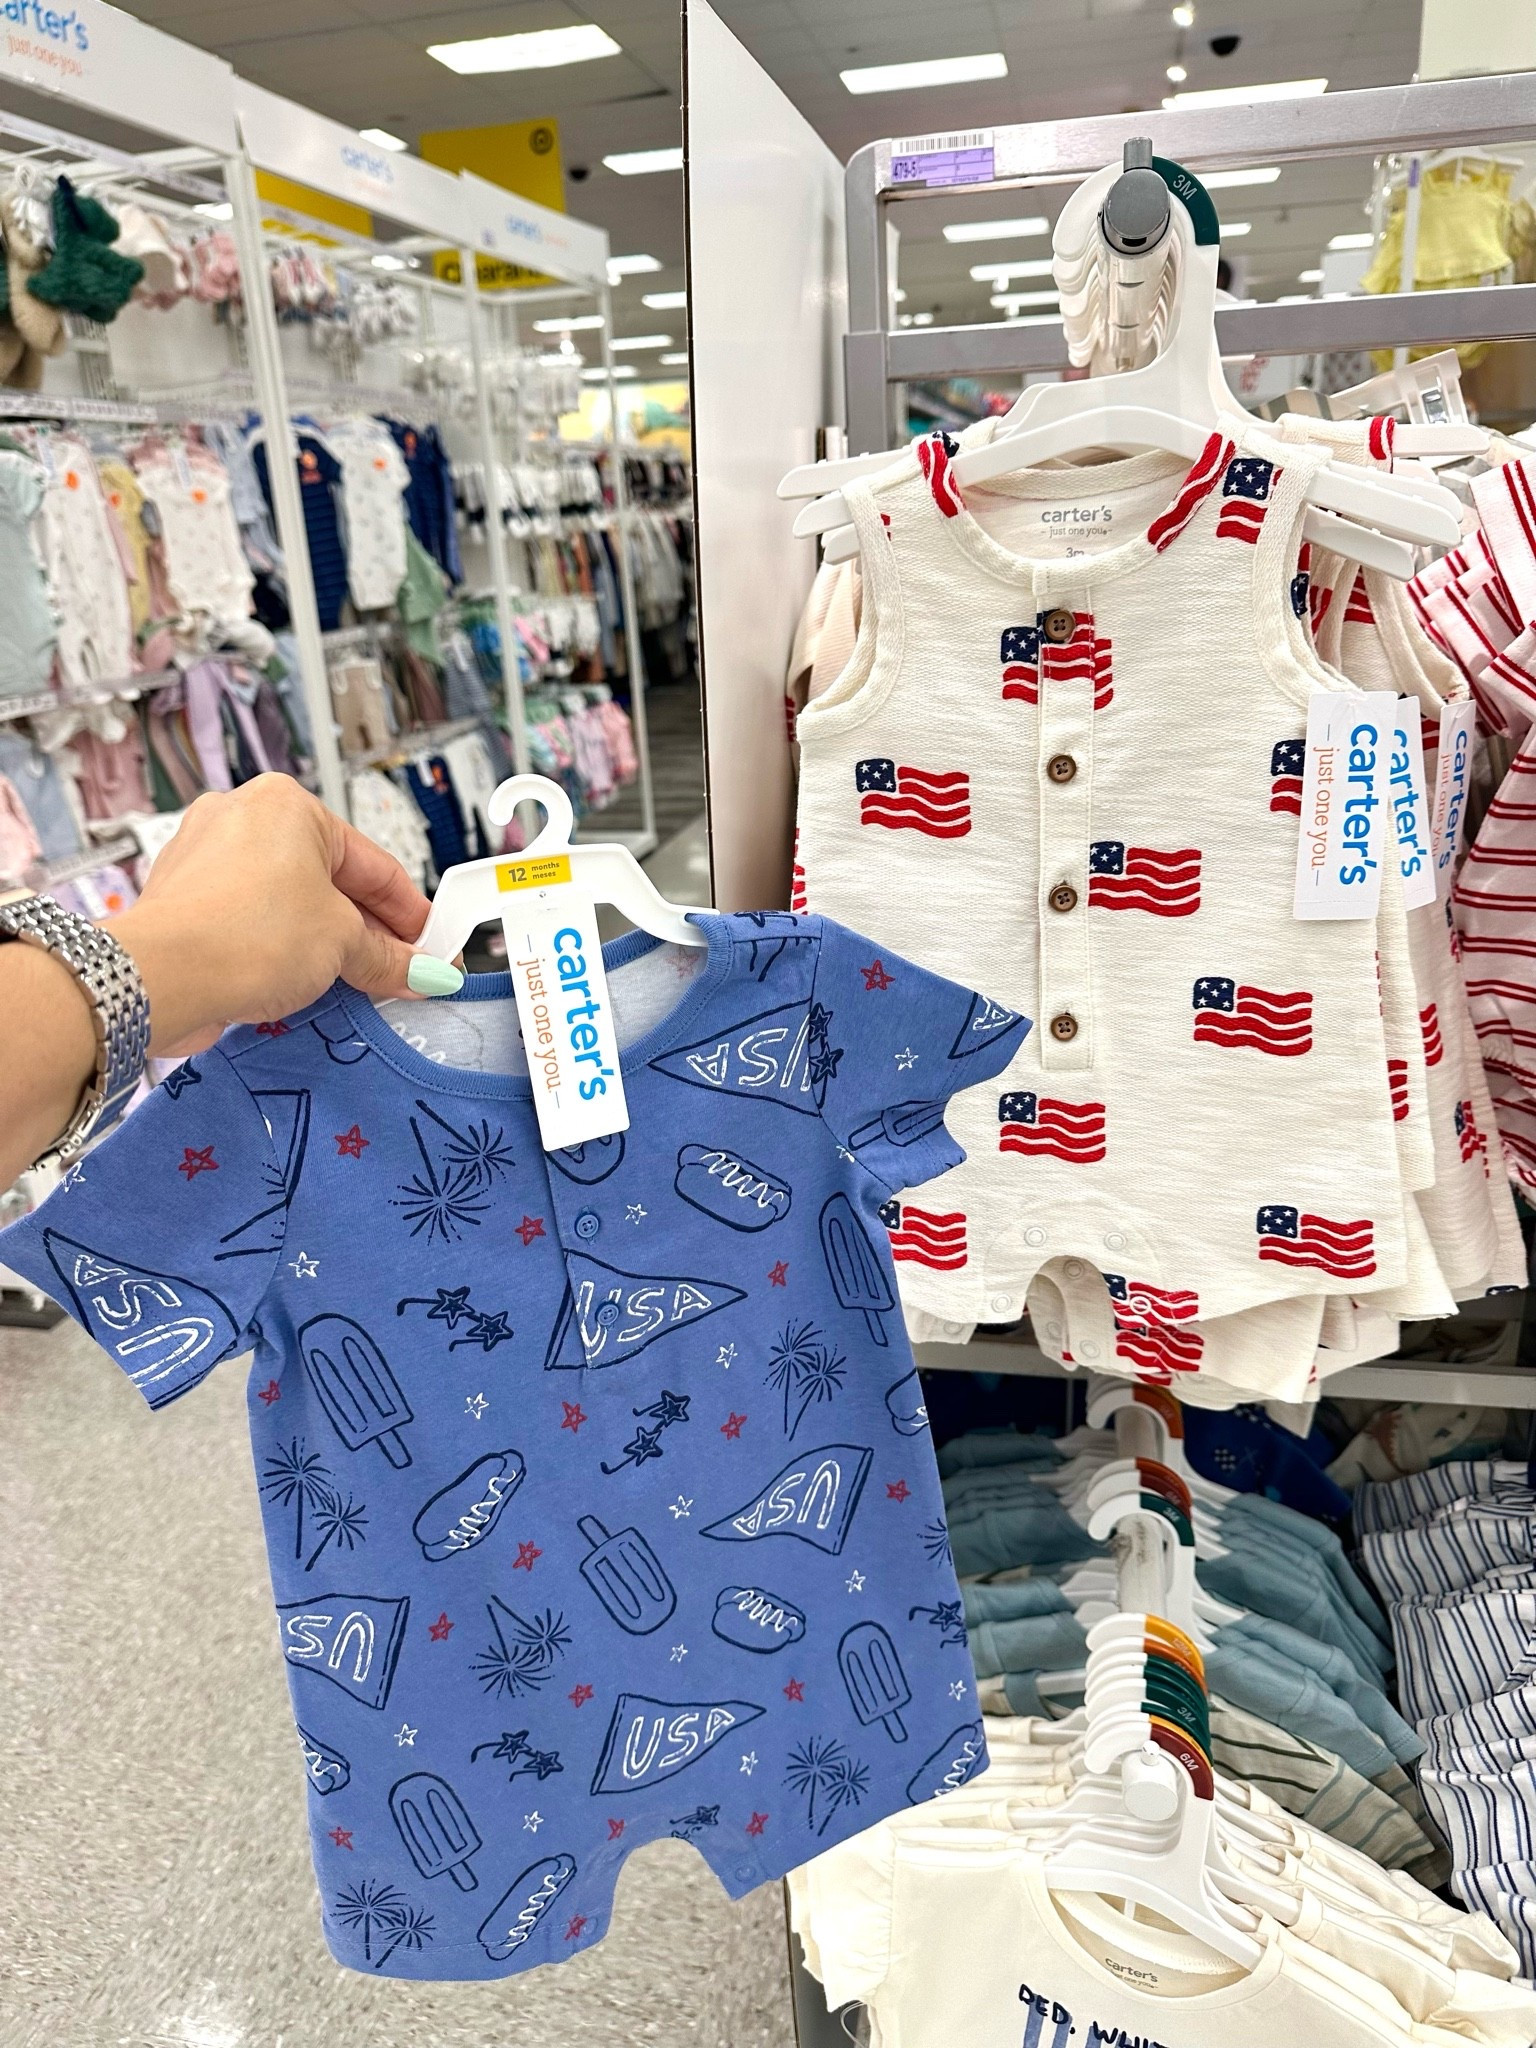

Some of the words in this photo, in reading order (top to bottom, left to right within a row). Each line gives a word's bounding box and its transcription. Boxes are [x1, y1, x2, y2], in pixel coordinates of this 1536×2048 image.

[0, 0, 89, 51] arter's
[1172, 174, 1198, 200] 3M
[1041, 505, 1113, 523] carter's
[1049, 526, 1067, 539] just
[1068, 527, 1085, 536] one
[1312, 747, 1340, 785] just
[1314, 789, 1331, 827] one
[1339, 723, 1379, 886] carter's
[1438, 730, 1468, 870] carter's
[508, 867, 527, 882] 12
[531, 862, 560, 872] months
[532, 871, 556, 880] meses
[517, 958, 548, 1001] just
[533, 1006, 554, 1045] one
[553, 927, 615, 1101] carter's
[74, 1254, 215, 1389] USA
[575, 1280, 713, 1362] USA
[732, 1459, 841, 1536] USA
[1176, 1705, 1197, 1723] 3M
[622, 1707, 736, 1780] USA
[1179, 1751, 1199, 1772] 6M
[1104, 1956, 1159, 1984] carter's
